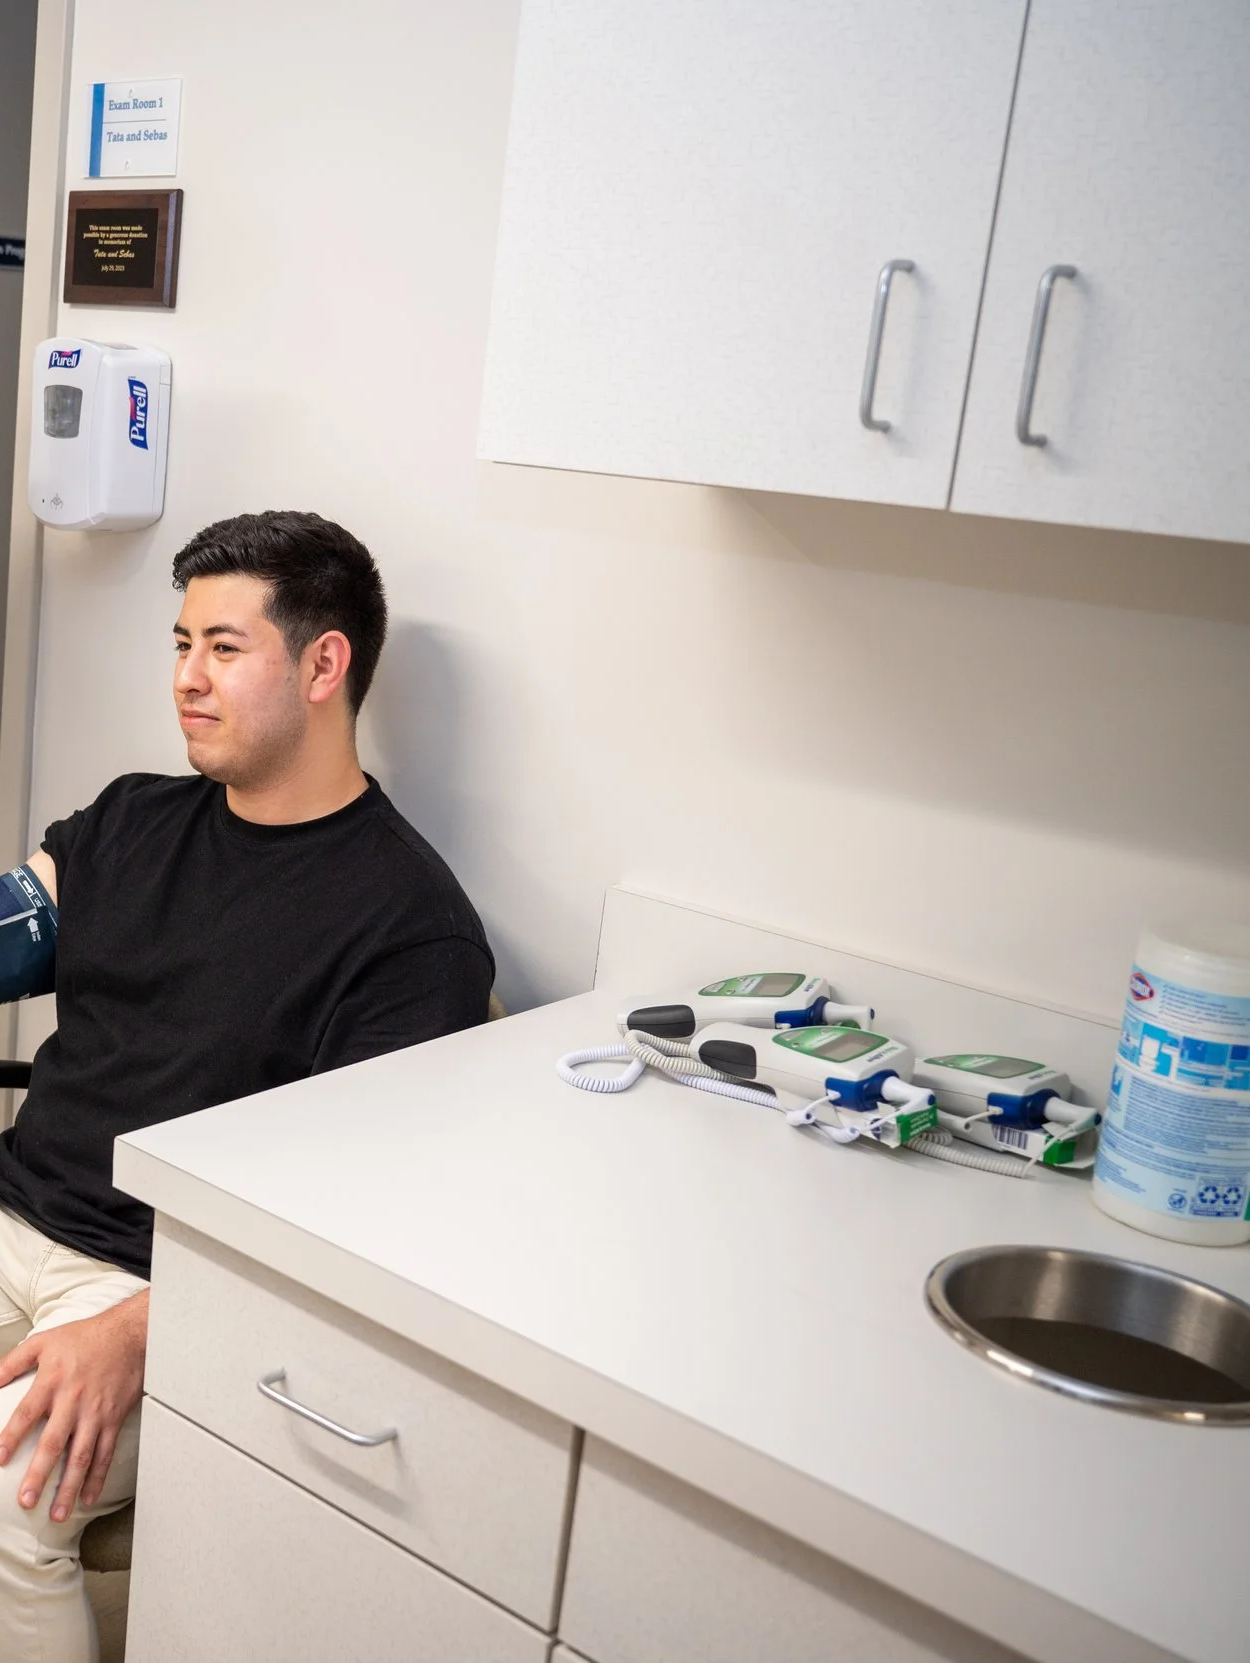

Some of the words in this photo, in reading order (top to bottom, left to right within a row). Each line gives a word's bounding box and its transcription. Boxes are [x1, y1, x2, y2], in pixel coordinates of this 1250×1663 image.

[108, 100, 130, 111] Exam
[132, 98, 157, 110] Room
[158, 97, 163, 108] 1
[106, 131, 124, 143] Tata
[125, 130, 142, 142] and
[143, 129, 168, 141] Sebas
[107, 250, 119, 258] and
[118, 249, 135, 258] Sebas
[52, 352, 78, 367] Purell
[131, 386, 146, 441] Purell
